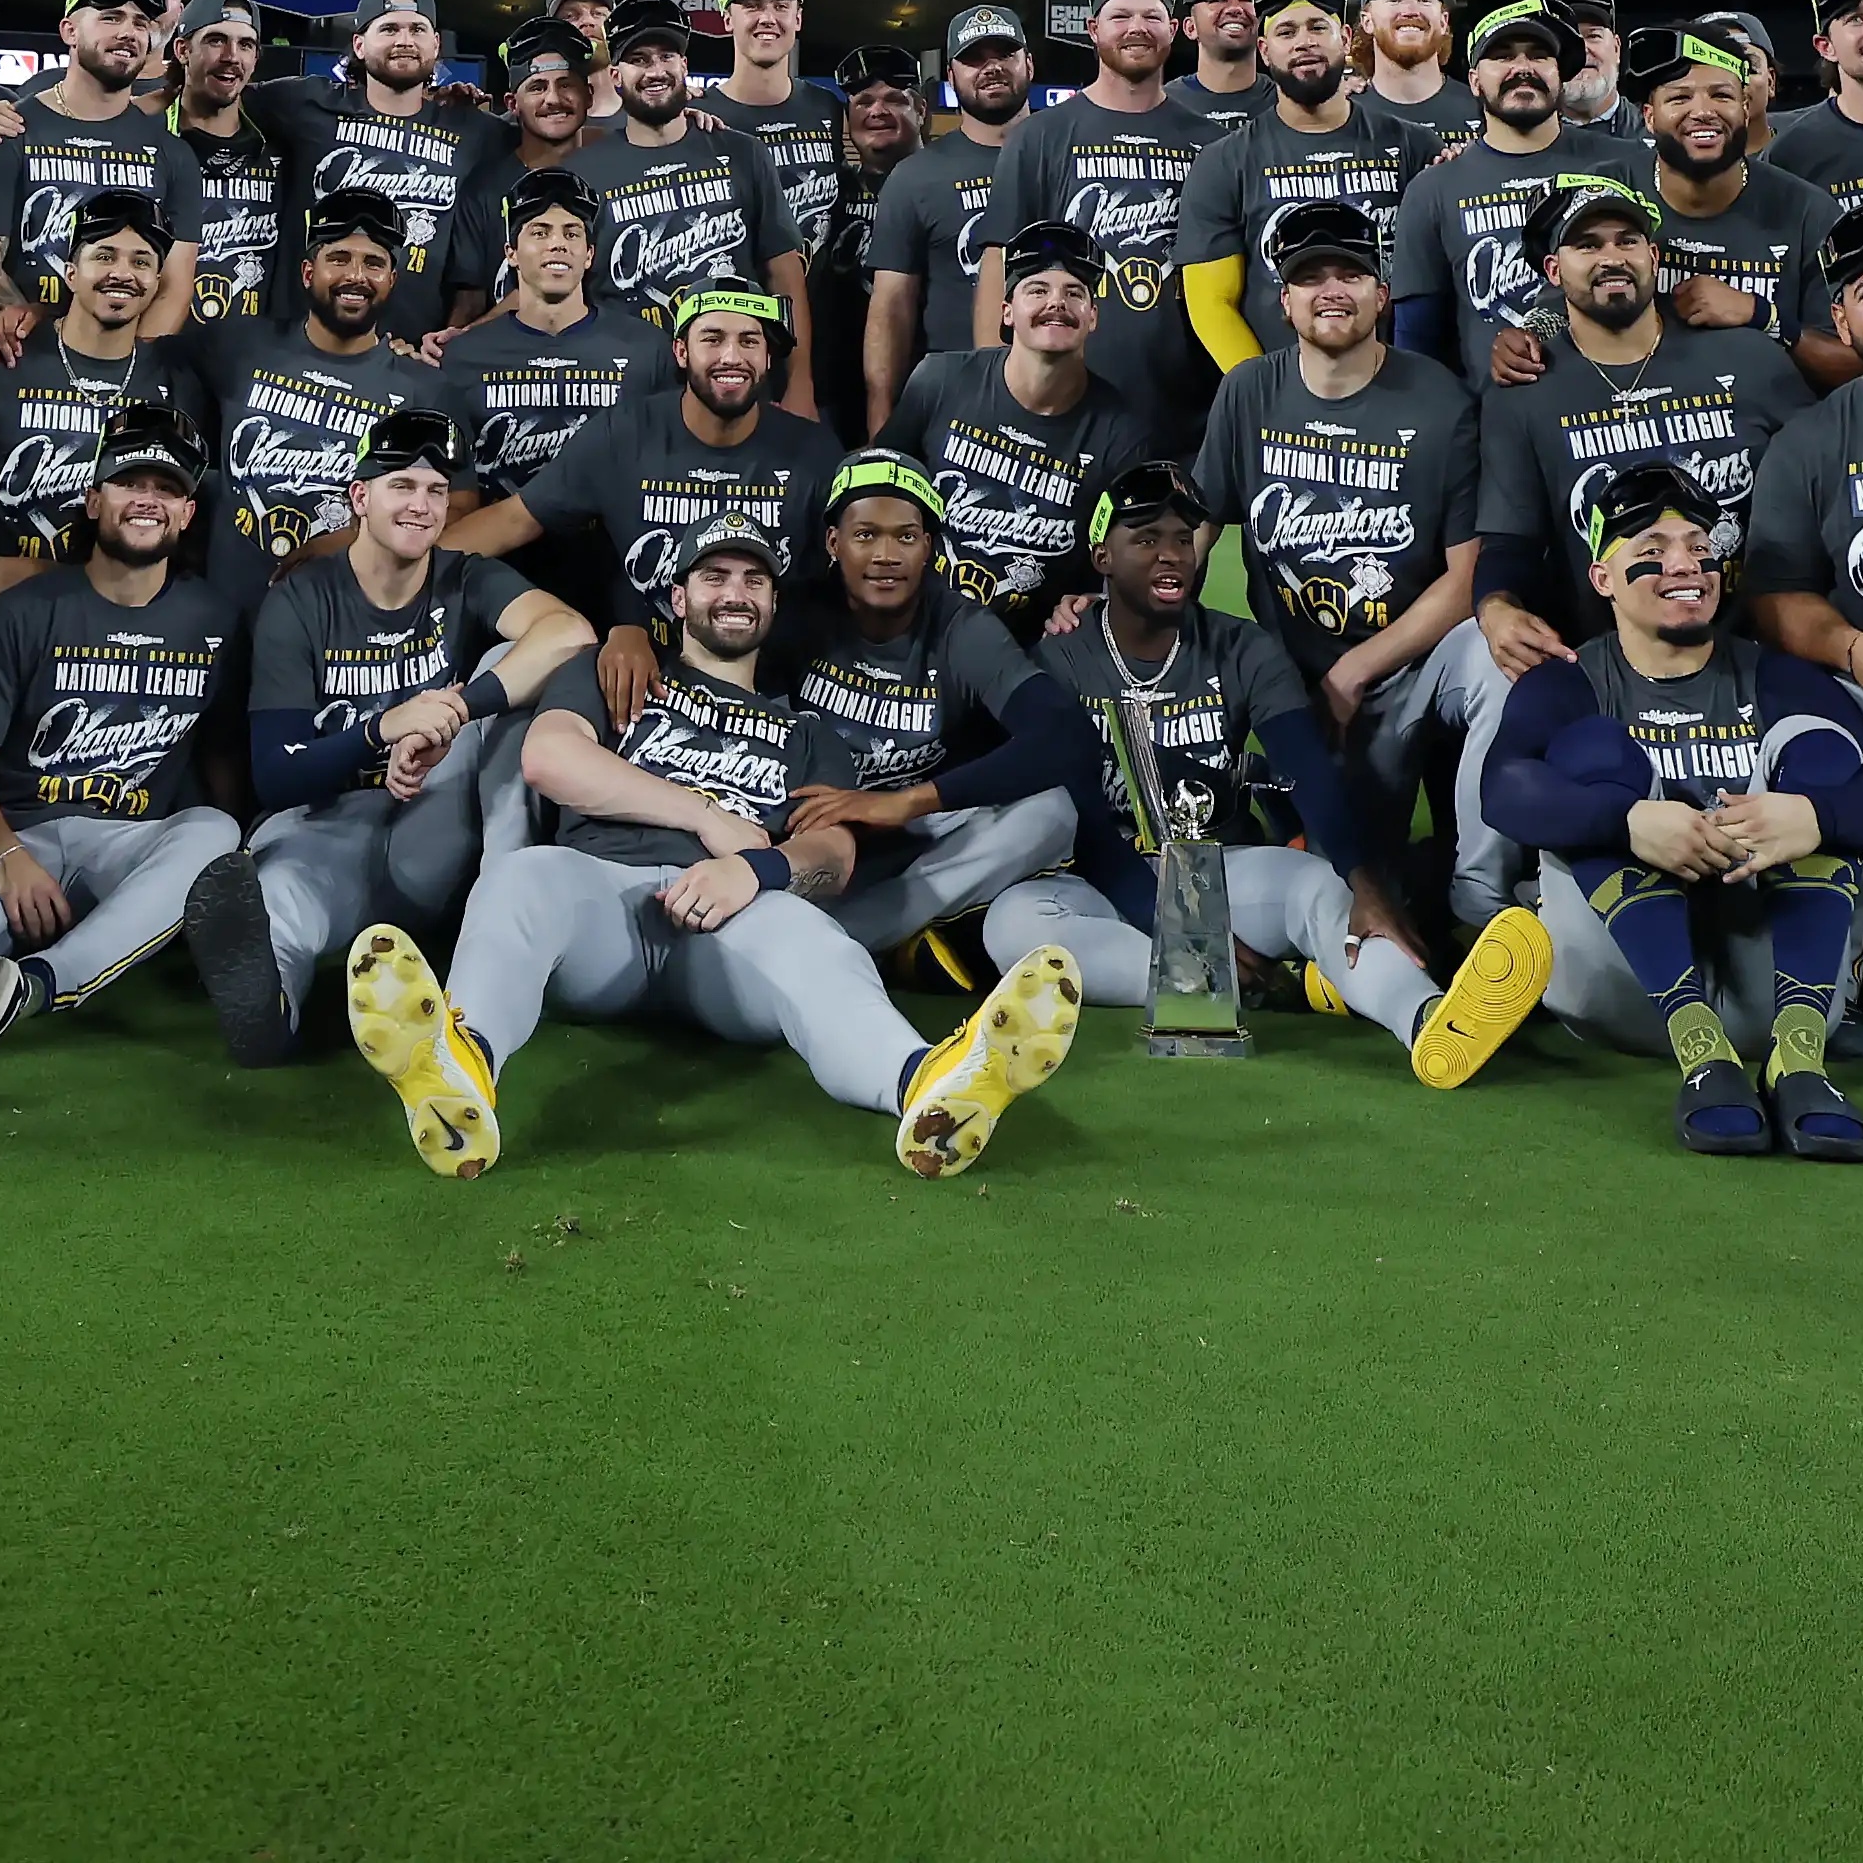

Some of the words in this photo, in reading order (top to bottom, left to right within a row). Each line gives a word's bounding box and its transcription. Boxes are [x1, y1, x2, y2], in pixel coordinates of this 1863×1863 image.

[336, 120, 404, 154] NATIONAL
[407, 136, 457, 168] LEAGUE
[28, 157, 98, 186] NATIONAL
[101, 160, 156, 188] LEAGUE
[313, 146, 458, 211] Champions
[1076, 157, 1147, 180] NATIONAL
[1268, 172, 1341, 200] NATIONAL
[1344, 169, 1400, 193] LEAGUE
[227, 177, 275, 203] LEAGUE
[611, 190, 679, 225] NATIONAL
[681, 178, 735, 210] LEAGUE
[406, 246, 425, 273] 26
[609, 208, 747, 291] Champions
[39, 276, 59, 304] 20
[240, 290, 259, 316] 26
[247, 383, 325, 427] NATIONAL
[485, 381, 562, 409] NATIONAL
[565, 382, 622, 408] LEAGUE
[19, 401, 101, 434] NATIONAL
[1568, 422, 1663, 461] NATIONAL
[1666, 409, 1736, 444] LEAGUE
[943, 433, 1016, 482] NATIONAL
[1018, 465, 1079, 508] LEAGUE
[1262, 445, 1336, 483] NATIONAL
[1338, 462, 1404, 493] LEAGUE
[932, 469, 1076, 557] Champions
[1249, 481, 1415, 564] Champions
[1364, 600, 1388, 627] 26
[55, 662, 139, 695] NATIONAL
[145, 665, 209, 697] LEAGUE
[324, 655, 400, 696] NATIONAL
[404, 640, 451, 688] LEAGUE
[799, 673, 877, 726] NATIONAL
[877, 697, 935, 734] LEAGUE
[724, 713, 794, 751] LEAGUE
[1161, 711, 1224, 749] LEAGUE
[1692, 742, 1760, 780] LEAGUE
[37, 776, 61, 804] 20
